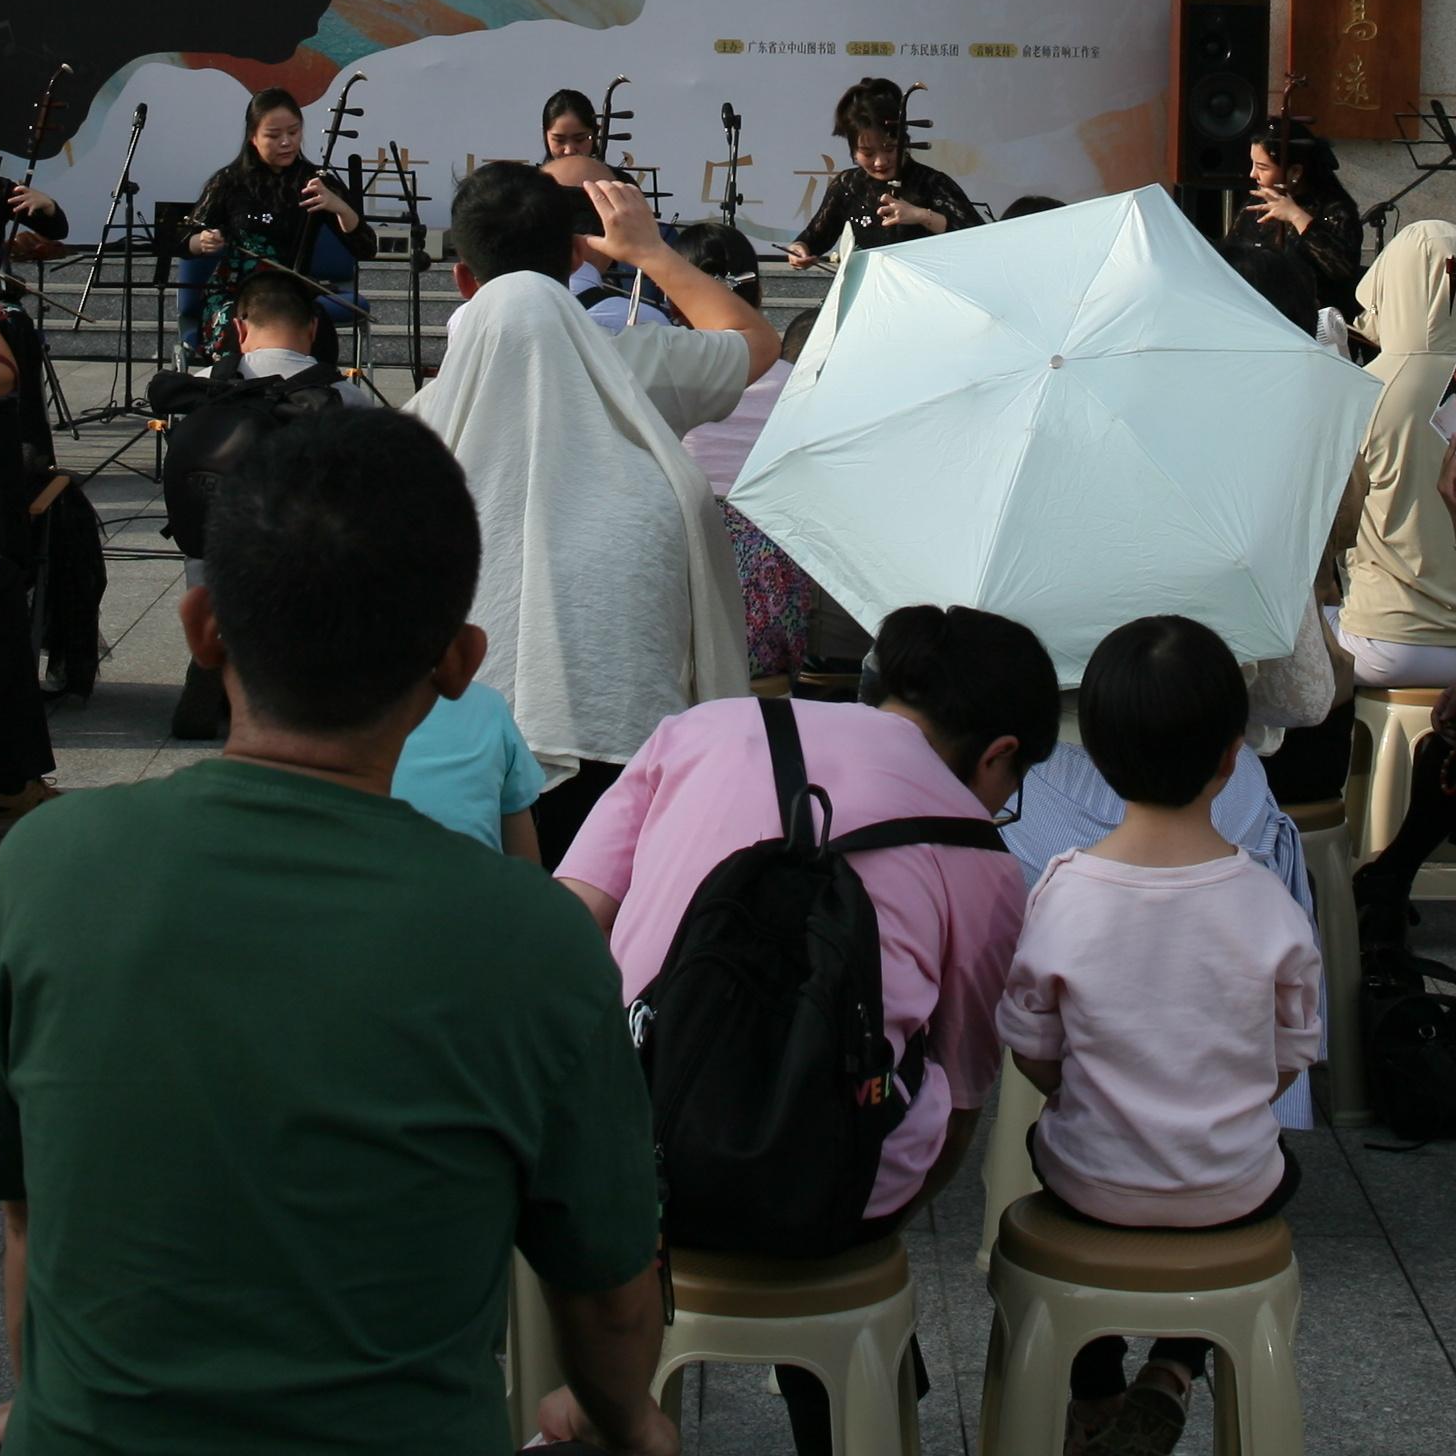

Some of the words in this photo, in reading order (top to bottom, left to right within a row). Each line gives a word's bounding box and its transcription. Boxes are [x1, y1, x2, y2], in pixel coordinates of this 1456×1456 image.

[747, 40, 837, 55] 广东省立中山图书馆
[900, 43, 960, 58] 广东民族乐团
